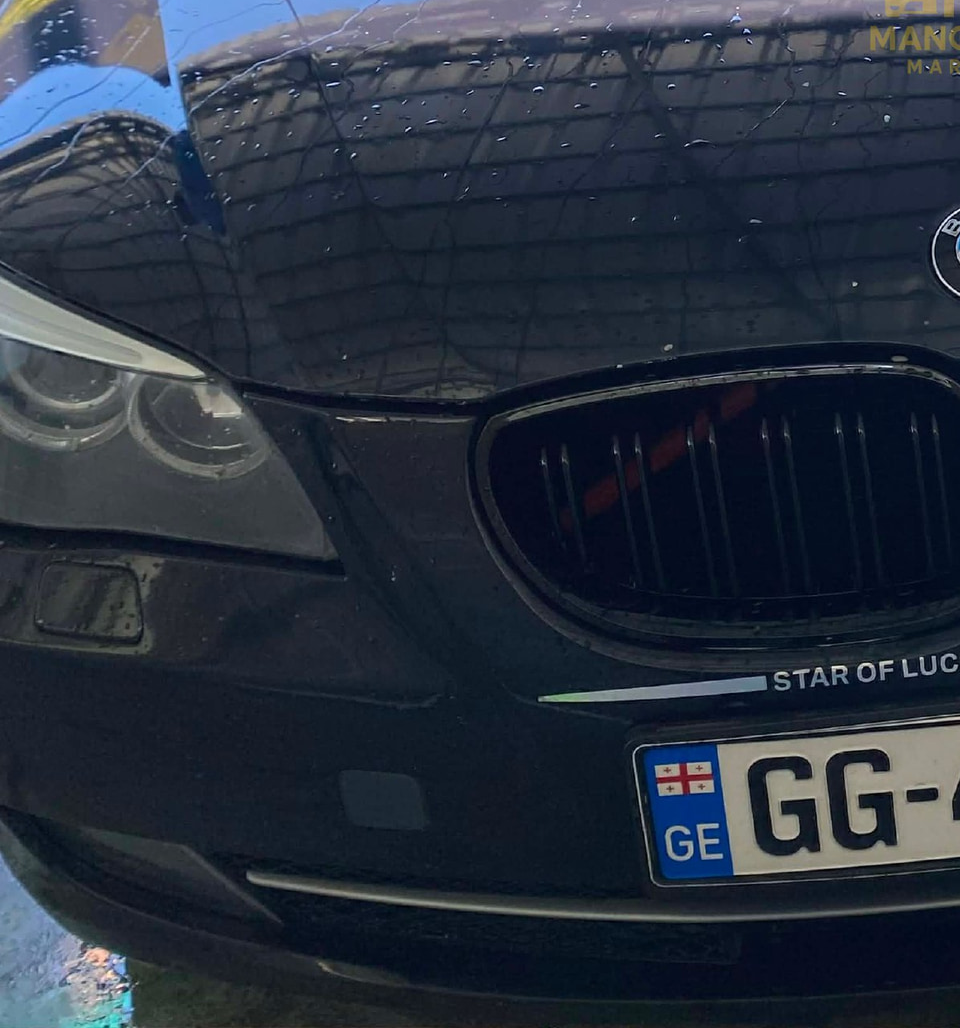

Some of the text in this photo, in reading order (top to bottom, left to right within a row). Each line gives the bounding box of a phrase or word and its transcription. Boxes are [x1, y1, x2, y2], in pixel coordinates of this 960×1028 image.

[773, 666, 850, 692] STAR
[855, 660, 896, 682] OF
[664, 822, 724, 862] GE
